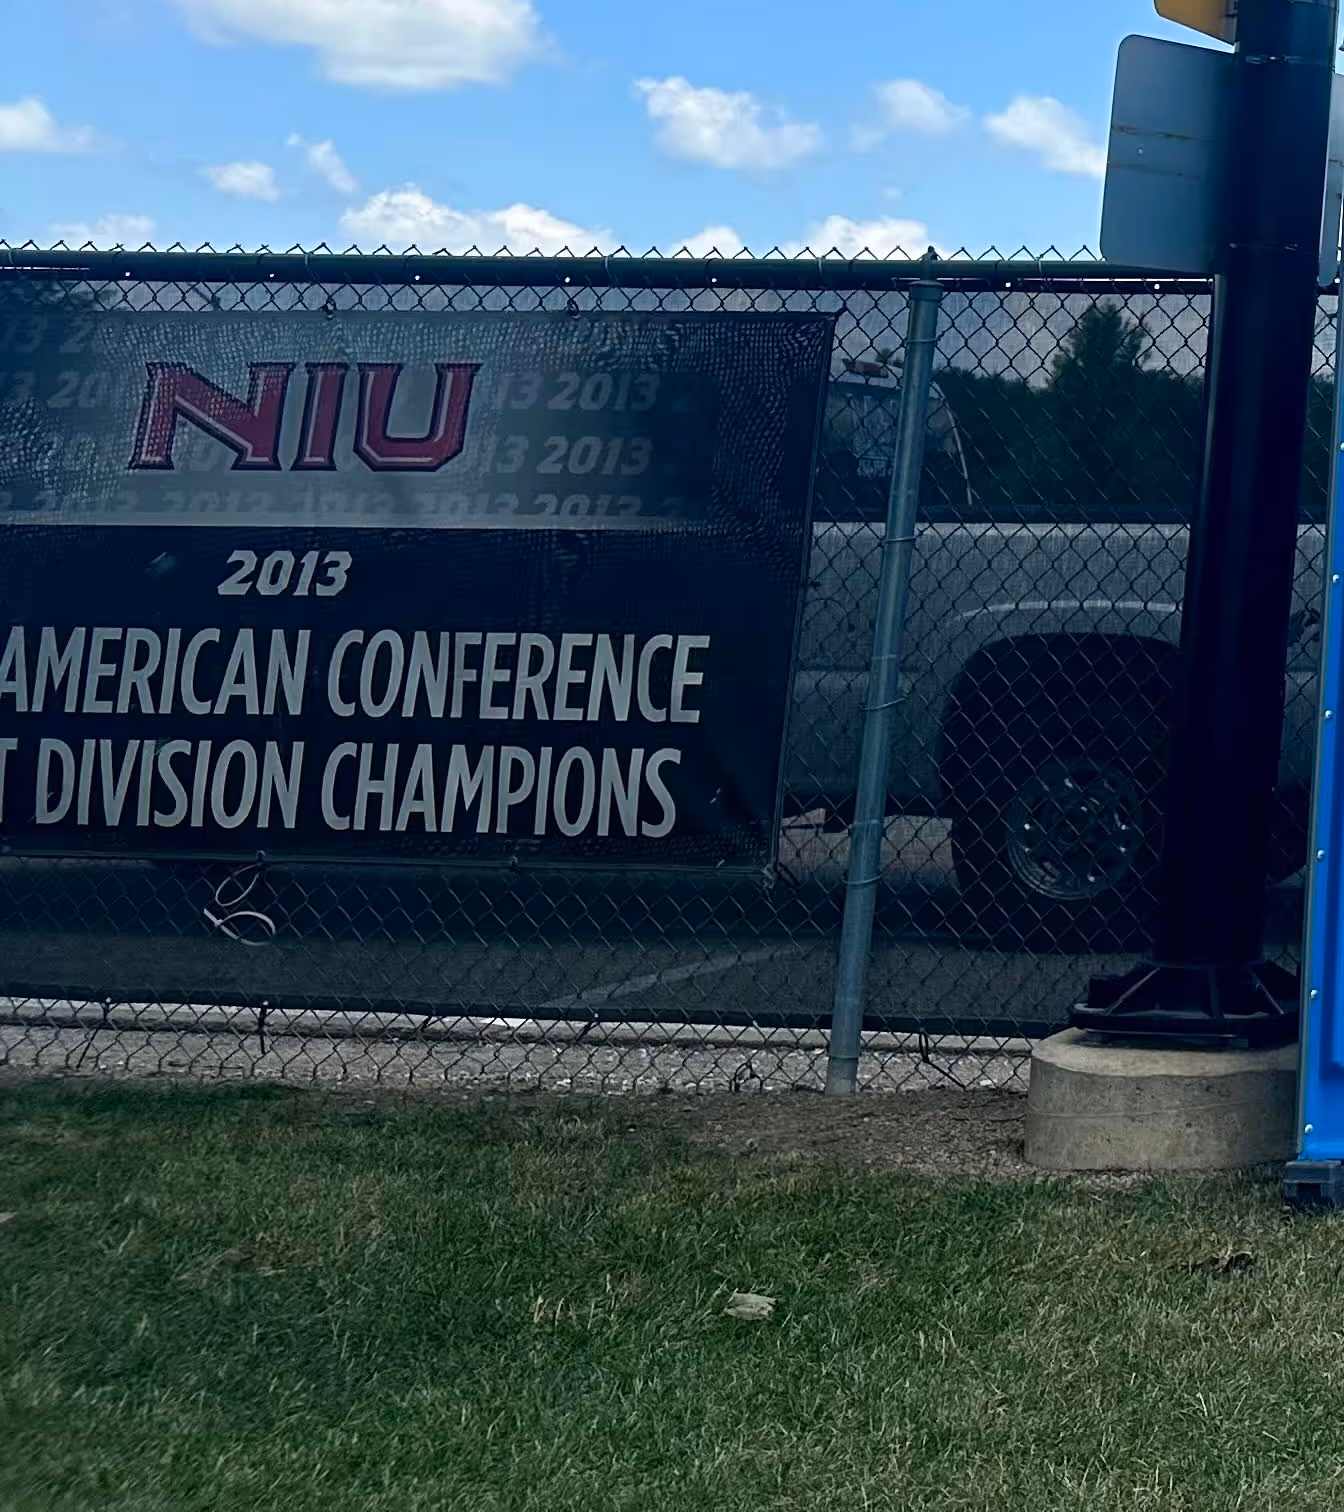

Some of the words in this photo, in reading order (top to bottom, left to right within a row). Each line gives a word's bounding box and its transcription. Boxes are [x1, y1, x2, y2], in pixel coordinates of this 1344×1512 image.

[128, 362, 482, 473] NIU
[216, 550, 353, 597] 2013
[0, 625, 311, 716] AMERICAN
[327, 629, 711, 723] CONFERENCE
[35, 738, 305, 829] DIVISION
[320, 741, 682, 838] CHAMPIONS
